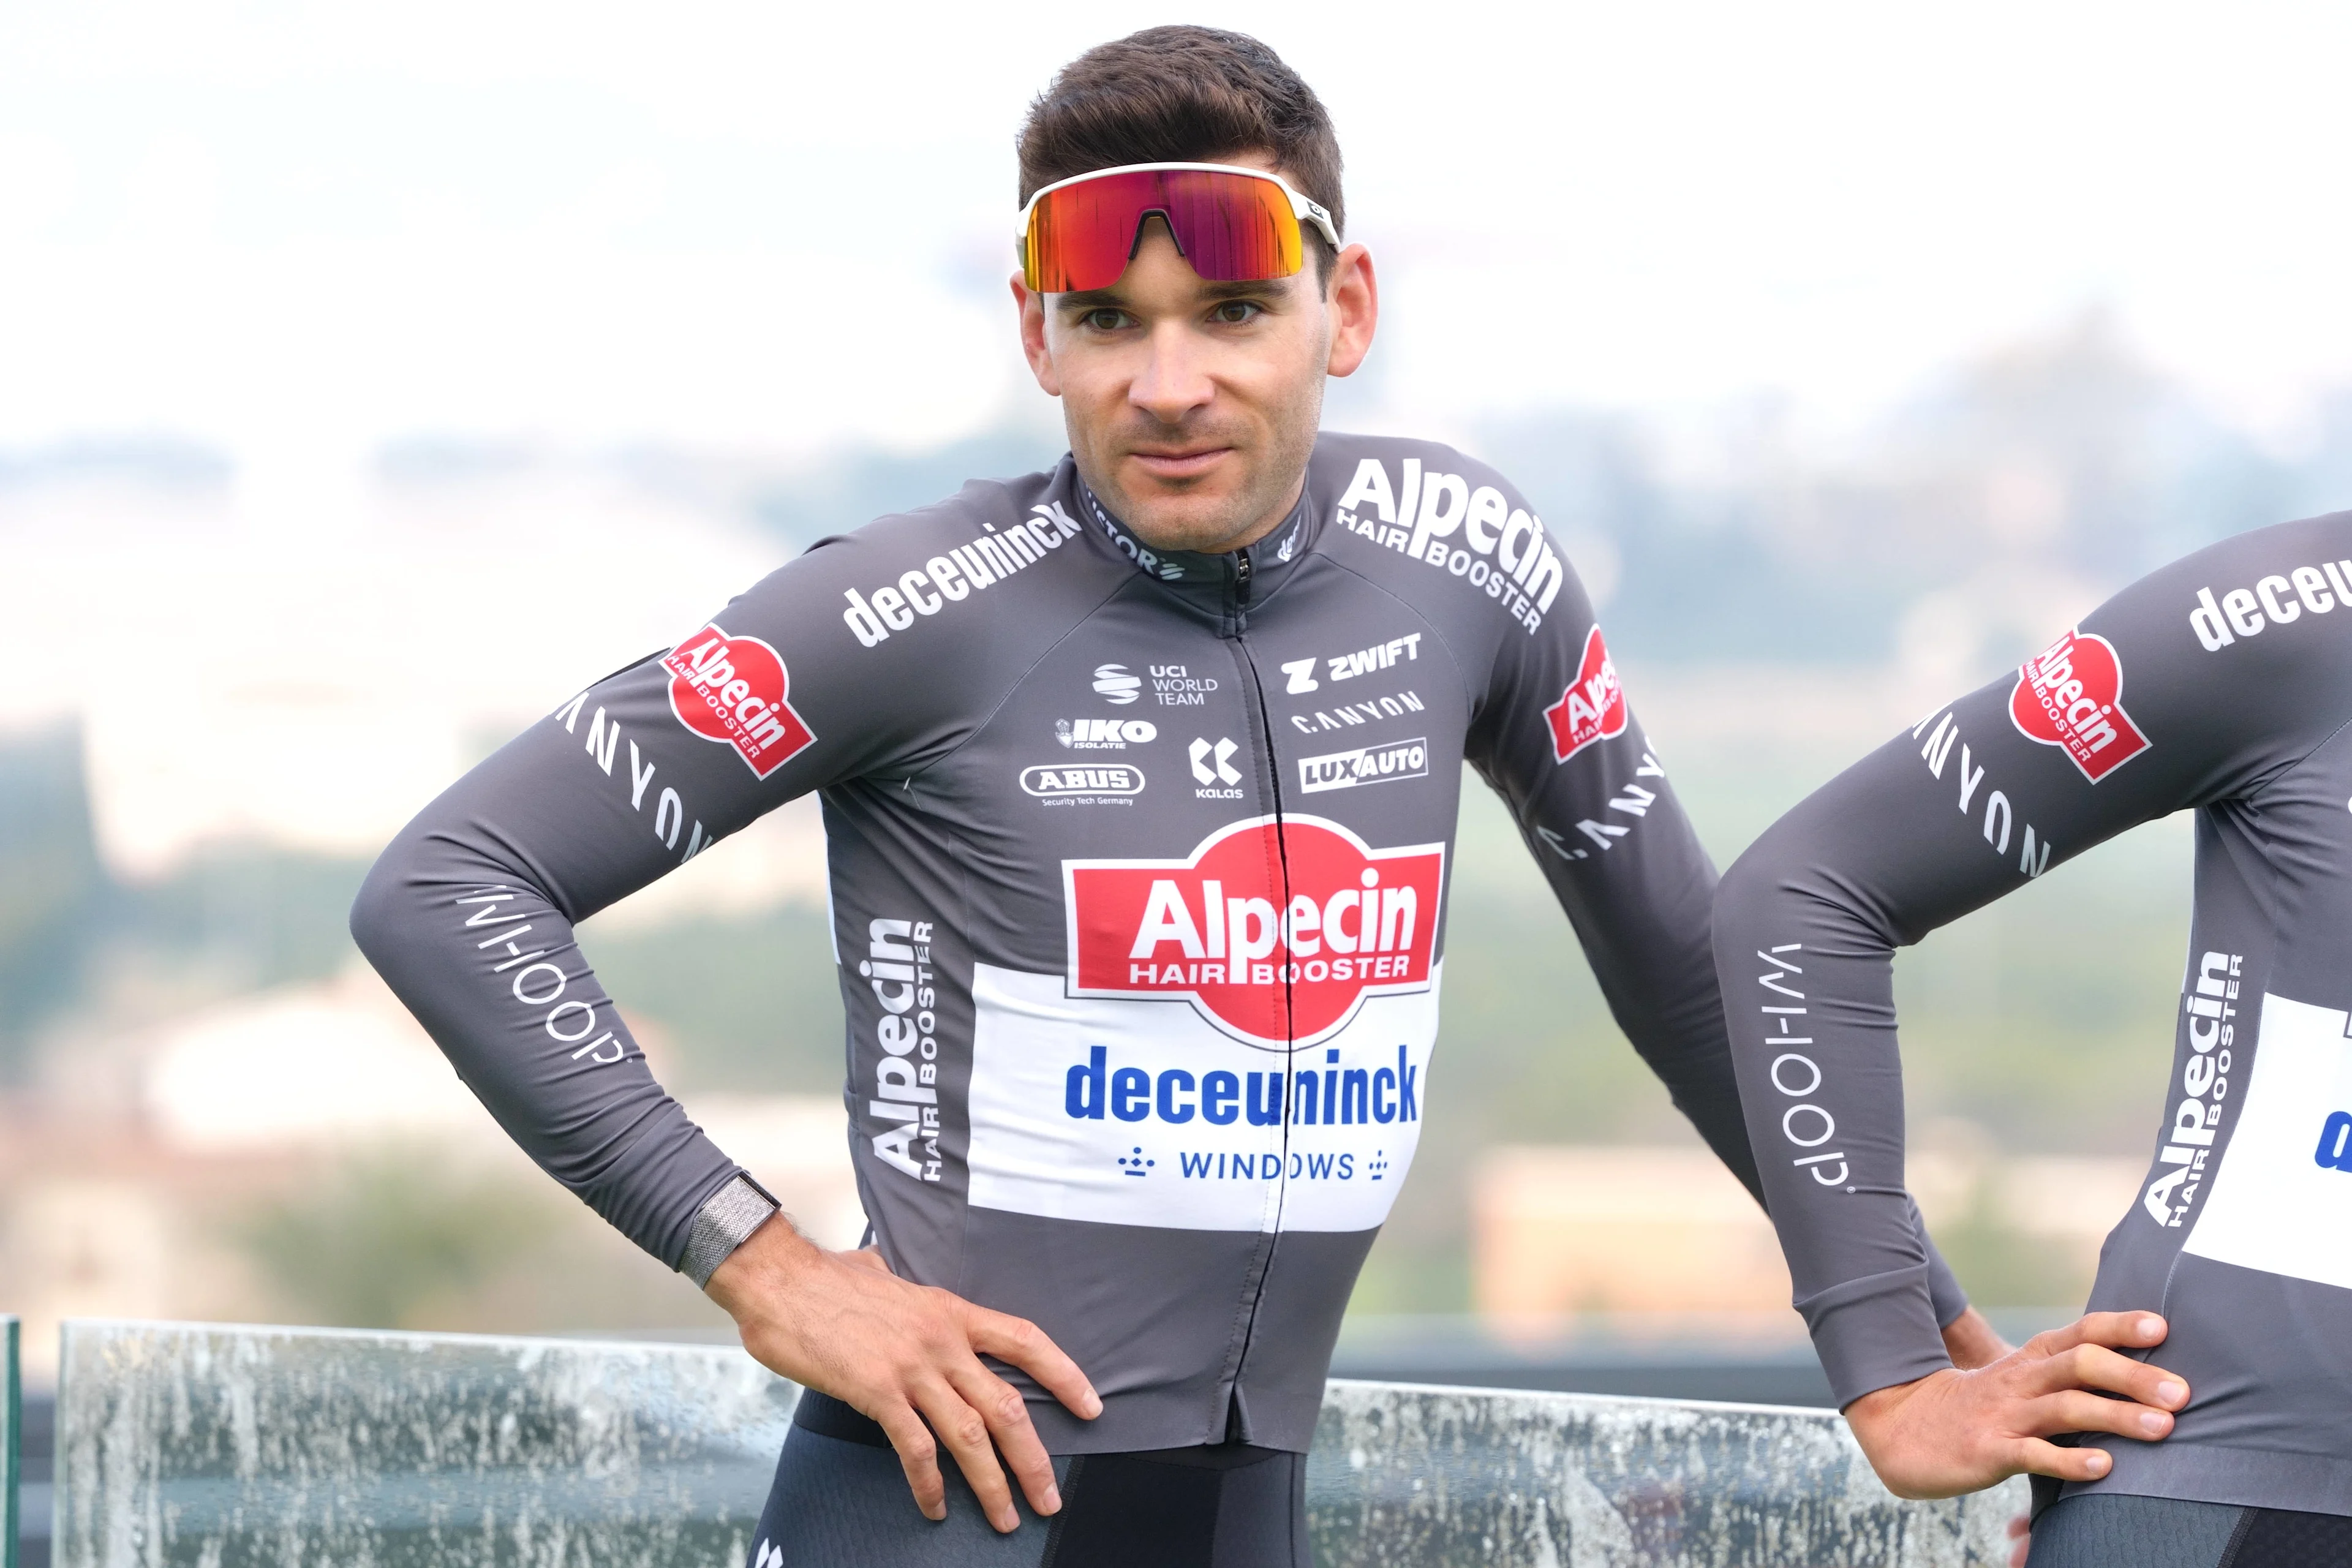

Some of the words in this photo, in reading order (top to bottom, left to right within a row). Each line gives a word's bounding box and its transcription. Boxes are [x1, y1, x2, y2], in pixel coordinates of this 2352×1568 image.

[843, 500, 1083, 647] deceuninck
[1336, 509, 1409, 553] HAIR
[1425, 541, 1541, 635] BOOSTER
[1338, 458, 1563, 615] Alpecin
[679, 638, 785, 750] Alpecin
[1149, 665, 1186, 677] UCI
[1153, 679, 1218, 691] WORLD
[1328, 632, 1421, 681] ZWIFT
[2032, 636, 2117, 753] Alpecin
[696, 685, 760, 760] BOOSTER
[1073, 719, 1157, 742] IKO
[1155, 693, 1204, 705] TEAM
[1291, 691, 1425, 734] CANYON
[2026, 660, 2040, 682] HAIR
[2035, 685, 2091, 761] BOOSTER
[1038, 770, 1130, 790] ABUS
[1098, 797, 1133, 806] Germany
[1537, 734, 1665, 859] CANY
[1128, 868, 1417, 984] Alpecin
[913, 921, 938, 1085] BOOSTER
[1130, 963, 1224, 984] HAIR
[1252, 955, 1409, 985] BOOSTER
[859, 918, 937, 1181] Alpecin
[1065, 1044, 1417, 1126] deceuninck
[2143, 951, 2229, 1227] Alpecin
[2168, 1150, 2210, 1227] HAIR
[2206, 954, 2243, 1126] BOOSTER
[921, 1106, 941, 1182] HAIR
[1180, 1152, 1354, 1180] WINDOWS
